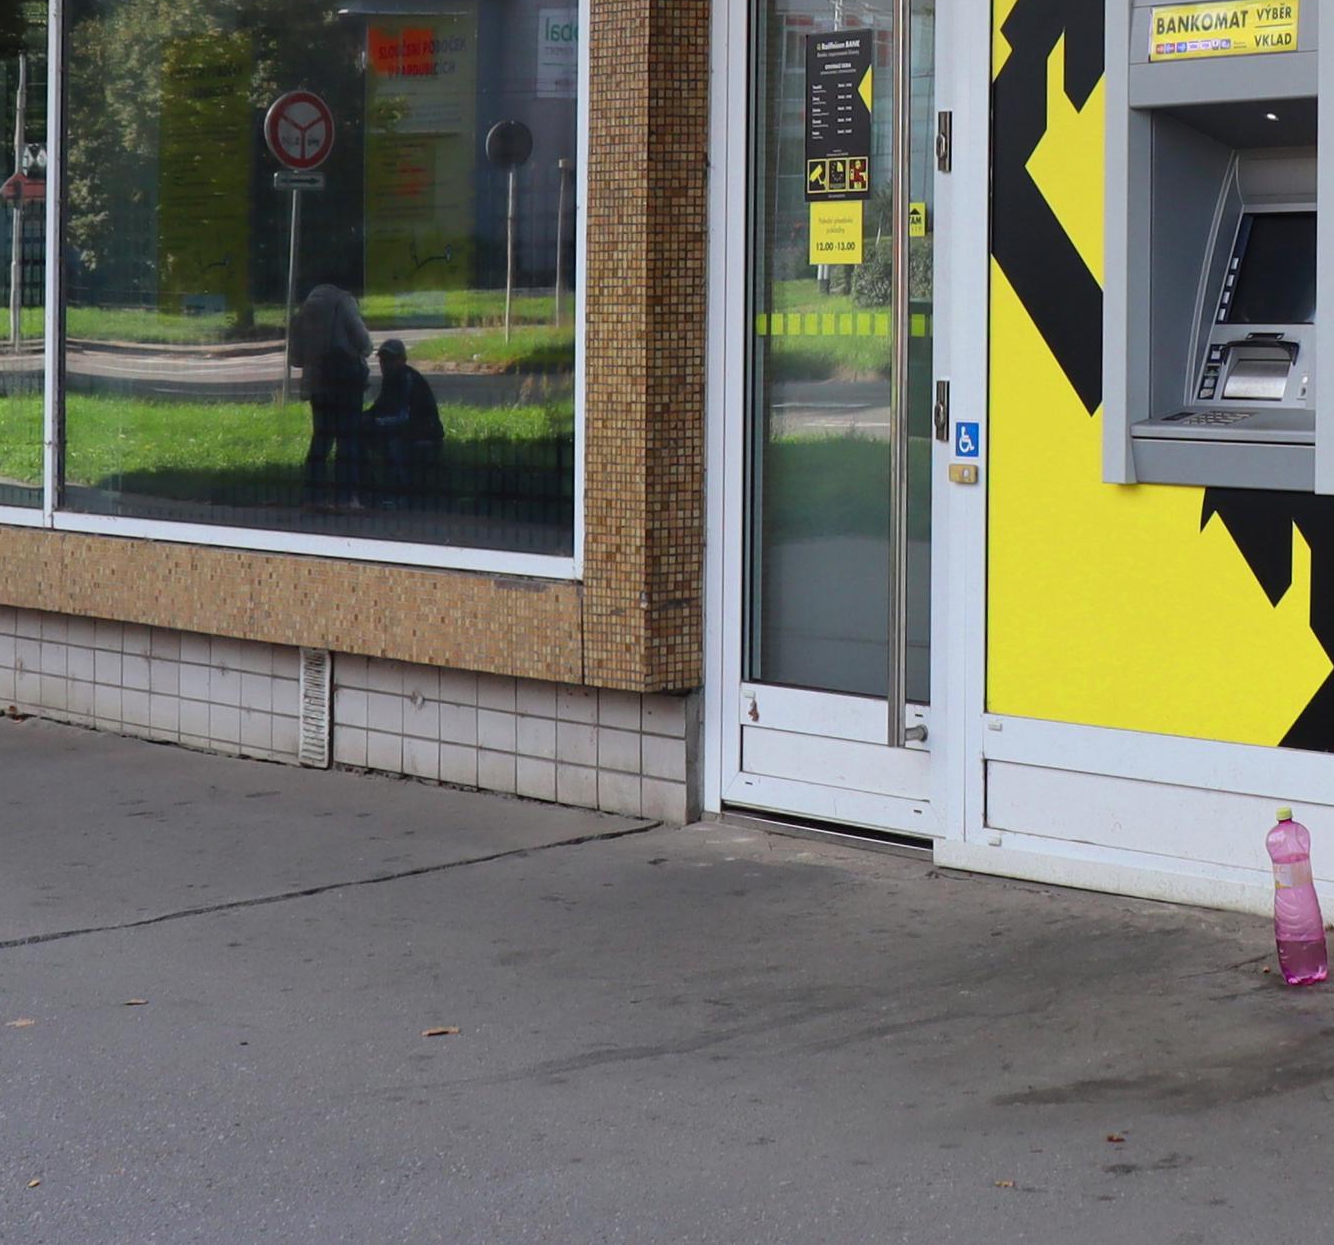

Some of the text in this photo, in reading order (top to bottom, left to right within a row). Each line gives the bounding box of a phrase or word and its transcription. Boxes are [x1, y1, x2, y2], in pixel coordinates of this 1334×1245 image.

[1156, 3, 1292, 35] BANKOMAT VÝBĚR
[1254, 33, 1292, 48] VKLAD
